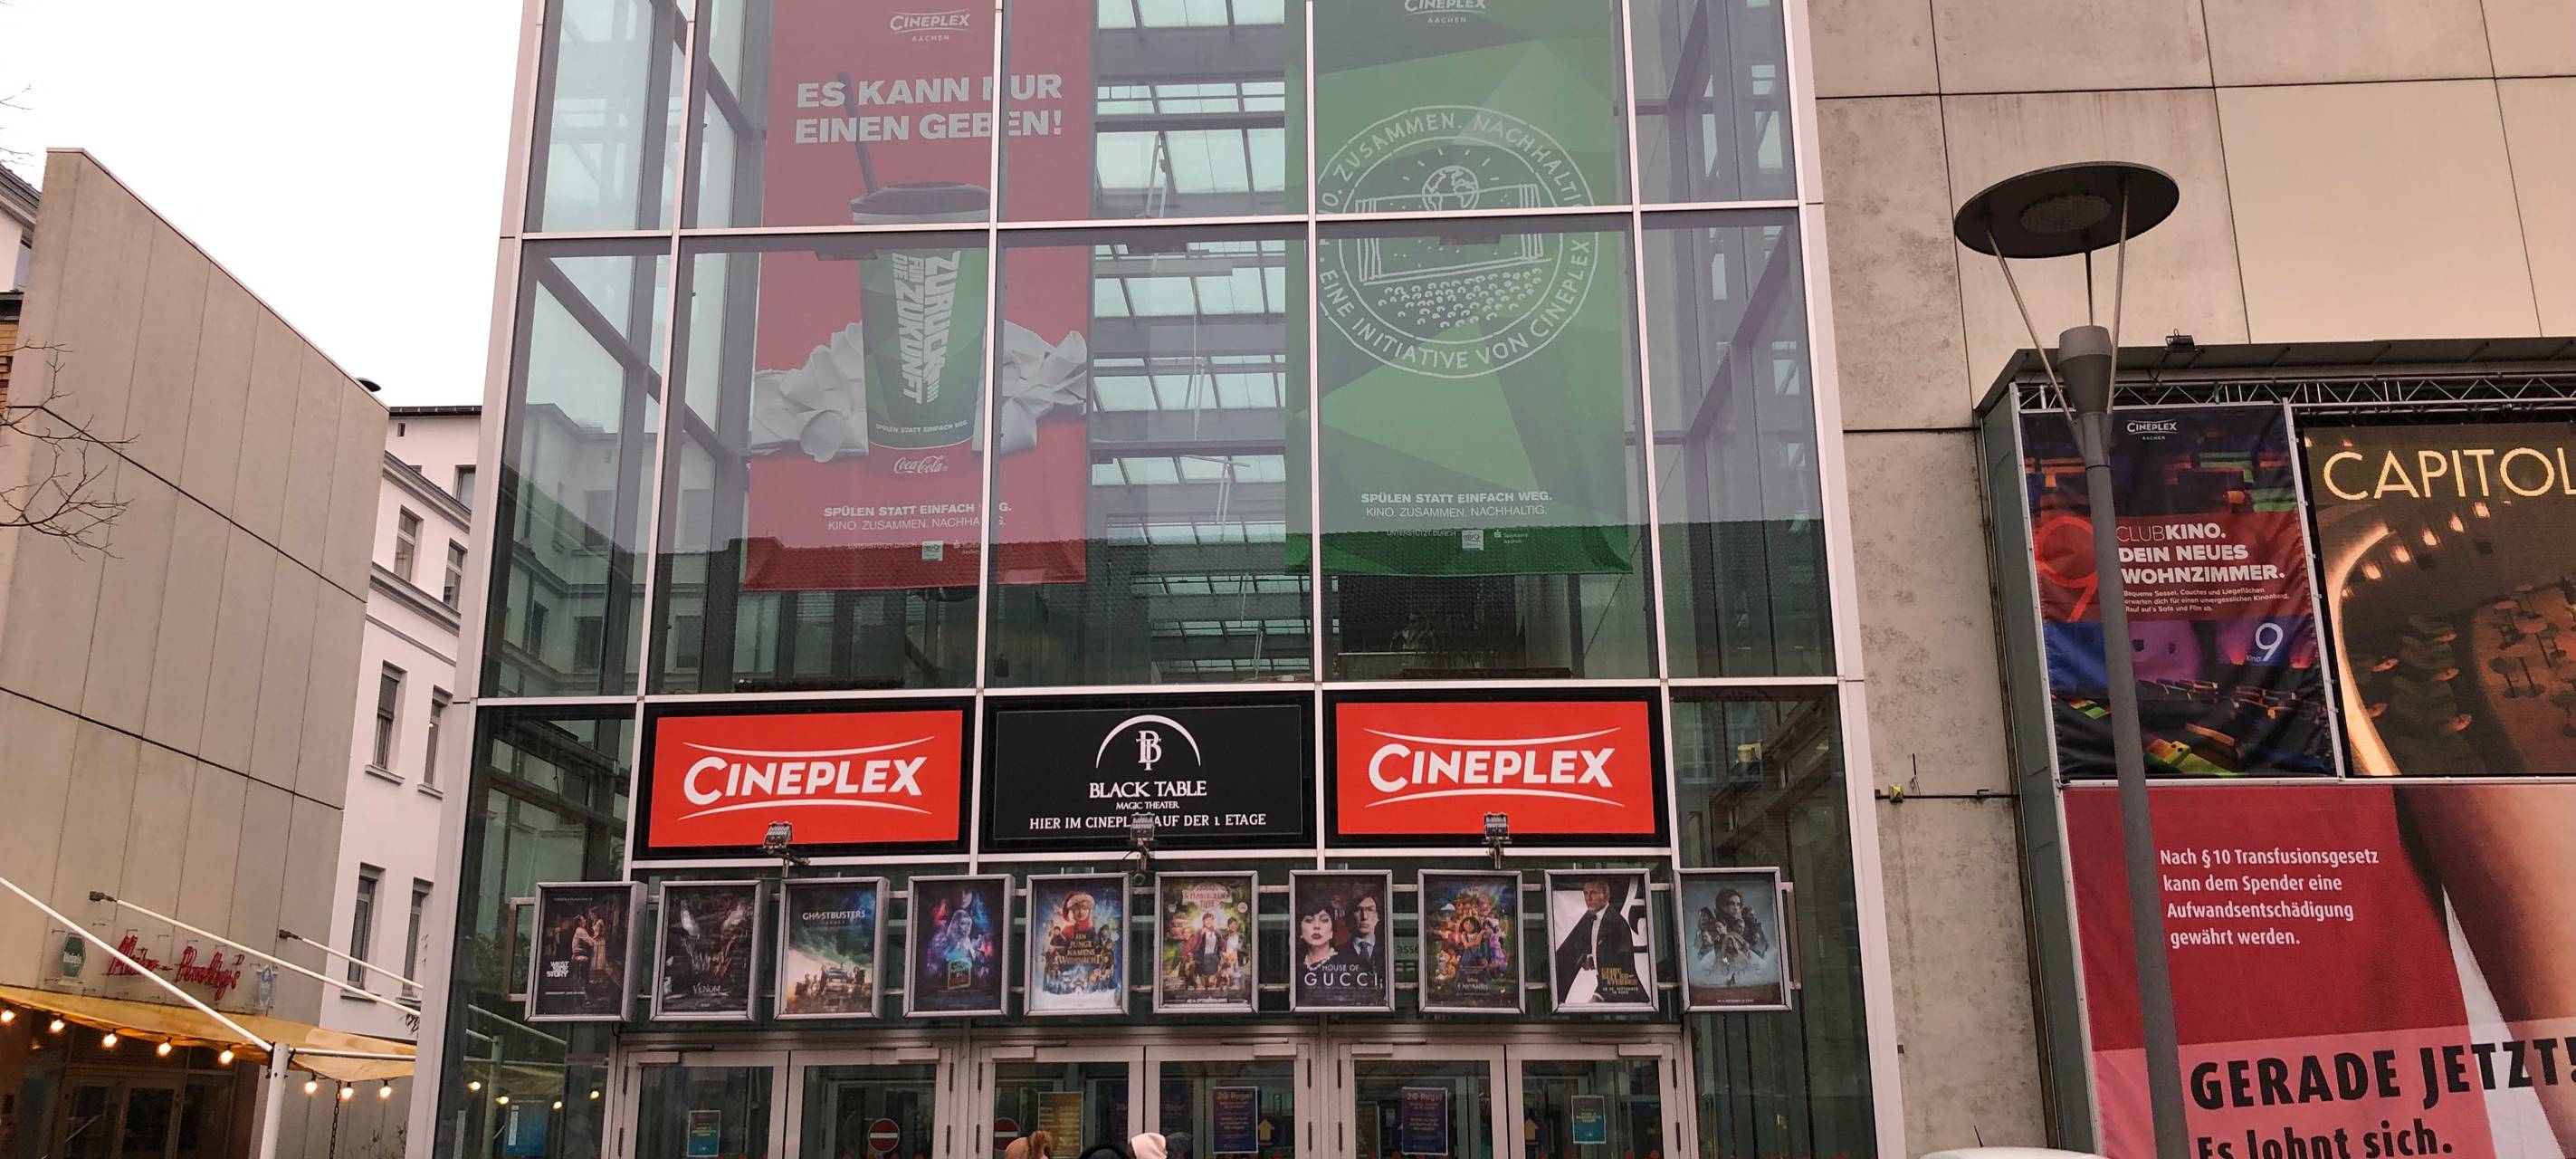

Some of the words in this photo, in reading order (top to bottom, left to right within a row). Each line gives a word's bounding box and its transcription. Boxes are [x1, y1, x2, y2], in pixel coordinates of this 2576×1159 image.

[891, 14, 970, 32] CINEPLEX
[911, 34, 950, 43] AACHEN
[797, 81, 846, 109] ES
[859, 78, 972, 106] KANN
[796, 115, 910, 143] EINEN
[1333, 111, 1463, 182] ZUSAMMEN.
[1320, 269, 1355, 319] EINE
[1351, 317, 1469, 369] INITIATIVE
[1476, 333, 1529, 365] VON
[1530, 239, 1590, 338] CINEPLEX
[894, 280, 925, 405] ZUKUNFT
[900, 426, 921, 435] STATT
[2126, 421, 2178, 435] CINEPLEX
[2323, 446, 2576, 501] CAPITOL
[1360, 491, 1412, 504] SPÜLEN
[1415, 493, 1454, 503] STATT
[1457, 492, 1514, 503] EINFACH
[1518, 491, 1553, 502] WEG.
[824, 505, 873, 517] SPÜLEN
[878, 505, 916, 516] STATT
[920, 503, 976, 514] EINFACH
[1366, 506, 1397, 518] KINO.
[1399, 507, 1467, 518] ZUSAMMEN.
[1470, 505, 1548, 516] NACHHALTIG.
[2119, 546, 2171, 563] DEIN
[2176, 543, 2248, 561] NEUES
[2121, 564, 2285, 585] WOHNZIMMER.
[2123, 589, 2153, 599] Bequeme
[2180, 588, 2207, 597] Couches
[2221, 586, 2265, 597] Liegeflächen
[2124, 598, 2152, 606] erwarten
[2153, 597, 2168, 605] dich
[2181, 596, 2199, 604] einen
[2200, 594, 2252, 606] unvergesslichen
[2253, 592, 2290, 602] Kinoabend.
[2175, 604, 2189, 612] und
[2189, 604, 2202, 612] Film
[2255, 622, 2284, 662] 9
[1368, 742, 1616, 793] CINEPLEX
[683, 756, 928, 806] CINEPLEX
[1089, 781, 1150, 799] BLACK
[1154, 780, 1207, 798] TABLE
[1115, 800, 1143, 810] MAGIC
[1144, 800, 1179, 810] THEATER
[1029, 816, 1061, 830] HIER
[1064, 816, 1082, 829] IM
[1085, 815, 1131, 829] CINEPL
[1153, 814, 1178, 828] AUF
[1184, 814, 1210, 827] DER
[1225, 813, 1267, 826] ETAGE
[2160, 848, 2197, 866] Nach
[2234, 848, 2380, 868] Transfusionsgesetz
[2163, 874, 2201, 892] kann
[2205, 874, 2238, 892] dem
[2241, 875, 2304, 896] Spender
[2308, 875, 2342, 891] eine
[2166, 900, 2354, 922] Aufwandsentschädigung
[2170, 927, 2235, 949] gewährt
[2237, 929, 2301, 945] werden.
[1321, 963, 1347, 972] HOUSE
[1349, 963, 1360, 972] OF
[1304, 972, 1379, 987] GUCCI
[2189, 1049, 2401, 1111] GERADE
[2419, 1037, 2576, 1111] JETZT!
[2198, 1136, 2232, 1159] Es
[2247, 1125, 2349, 1159] lohnt
[2363, 1118, 2454, 1159] sich.
